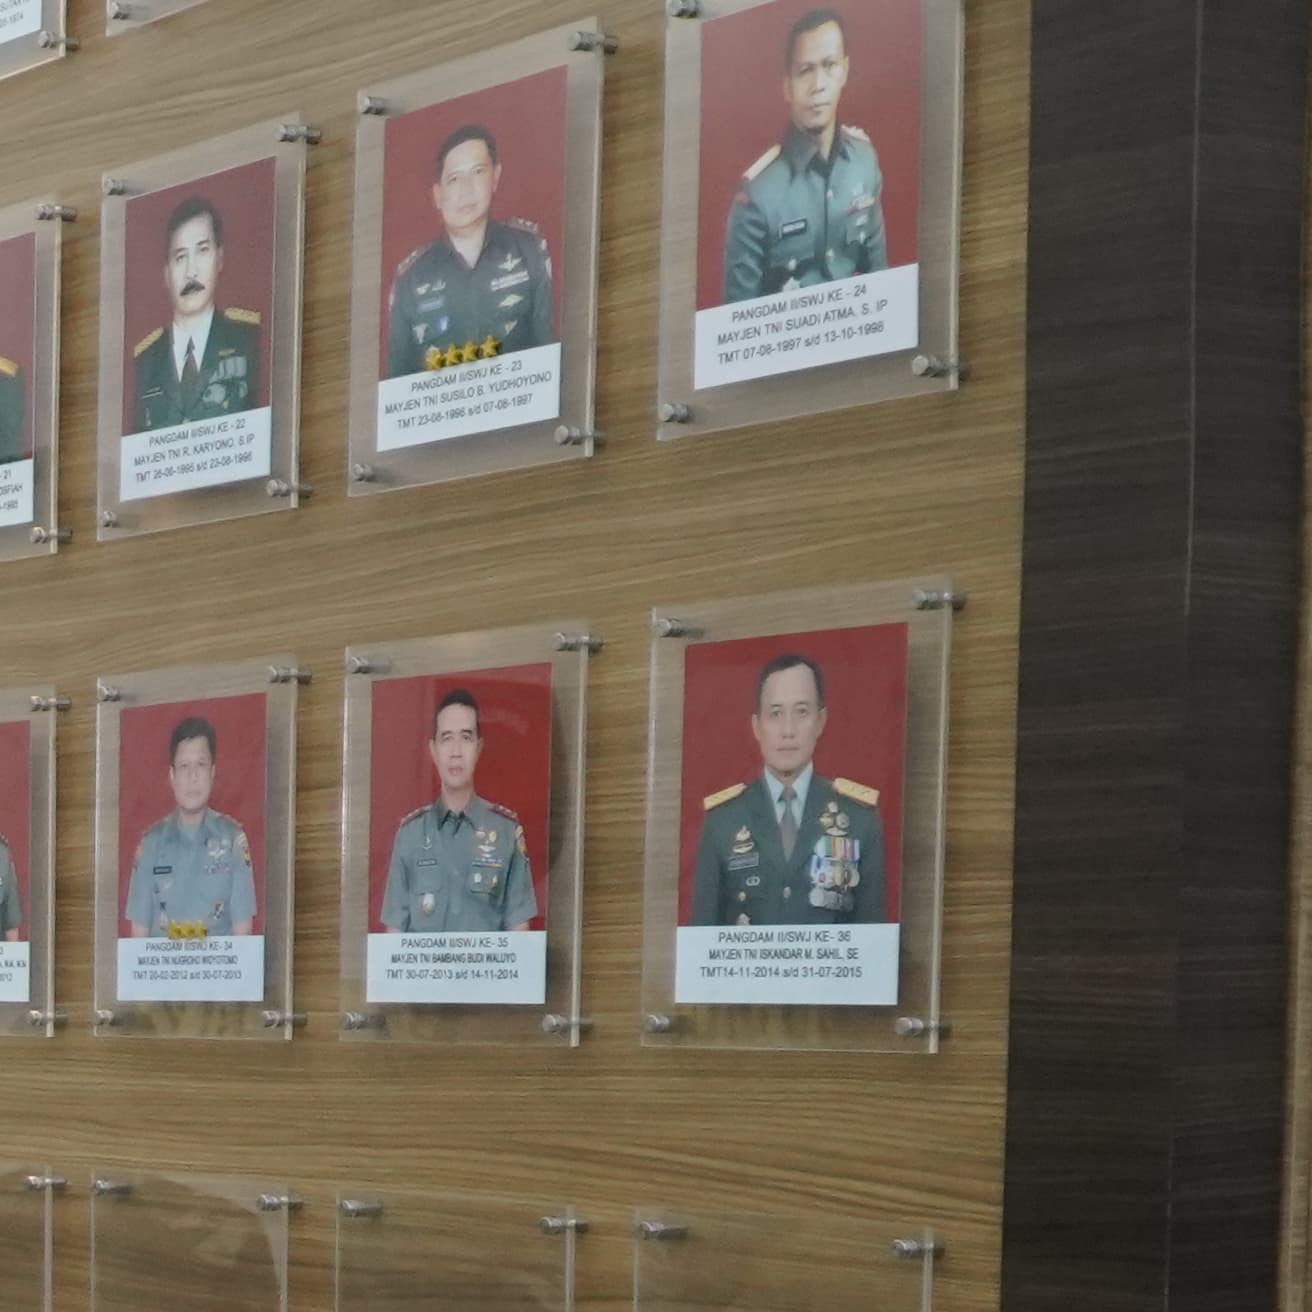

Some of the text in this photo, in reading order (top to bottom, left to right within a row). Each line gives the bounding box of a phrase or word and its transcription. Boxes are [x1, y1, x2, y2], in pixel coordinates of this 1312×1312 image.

[731, 300, 786, 323] PANGDAM
[827, 287, 843, 303] KE
[853, 282, 866, 297] 24
[717, 324, 761, 345] MAYJEN
[764, 319, 782, 335] TNI
[785, 311, 820, 331] SUADI
[876, 297, 888, 312] IP
[718, 349, 741, 365] TMT
[804, 332, 820, 348] s/d
[410, 373, 456, 393] PANGDAM
[489, 363, 502, 376] KE
[511, 359, 522, 371] 23
[384, 397, 420, 415] MAYJEN
[423, 393, 438, 407] TNI
[439, 386, 474, 404] SUSILO
[488, 369, 552, 394] YUDHOYONO
[397, 416, 415, 430] TMT
[148, 428, 189, 447] PANGDAM
[217, 421, 228, 433] KE
[133, 450, 165, 466] MAYJEN
[135, 469, 151, 483] TMT
[401, 937, 446, 948] PANGDAM
[496, 936, 508, 947] 35
[718, 931, 773, 943] PANGDAM
[837, 930, 851, 942] 36
[145, 941, 182, 952] PANGDAM
[708, 948, 741, 960] MAYJEN
[743, 948, 757, 960] TNI
[759, 947, 803, 960] ISKANDAR
[847, 947, 859, 959] SE
[391, 953, 417, 964] MAYJEN
[431, 953, 466, 963] BAMBANG
[386, 969, 403, 979] TMT
[782, 966, 798, 978] s/d
[802, 966, 862, 978] 31-07-2015
